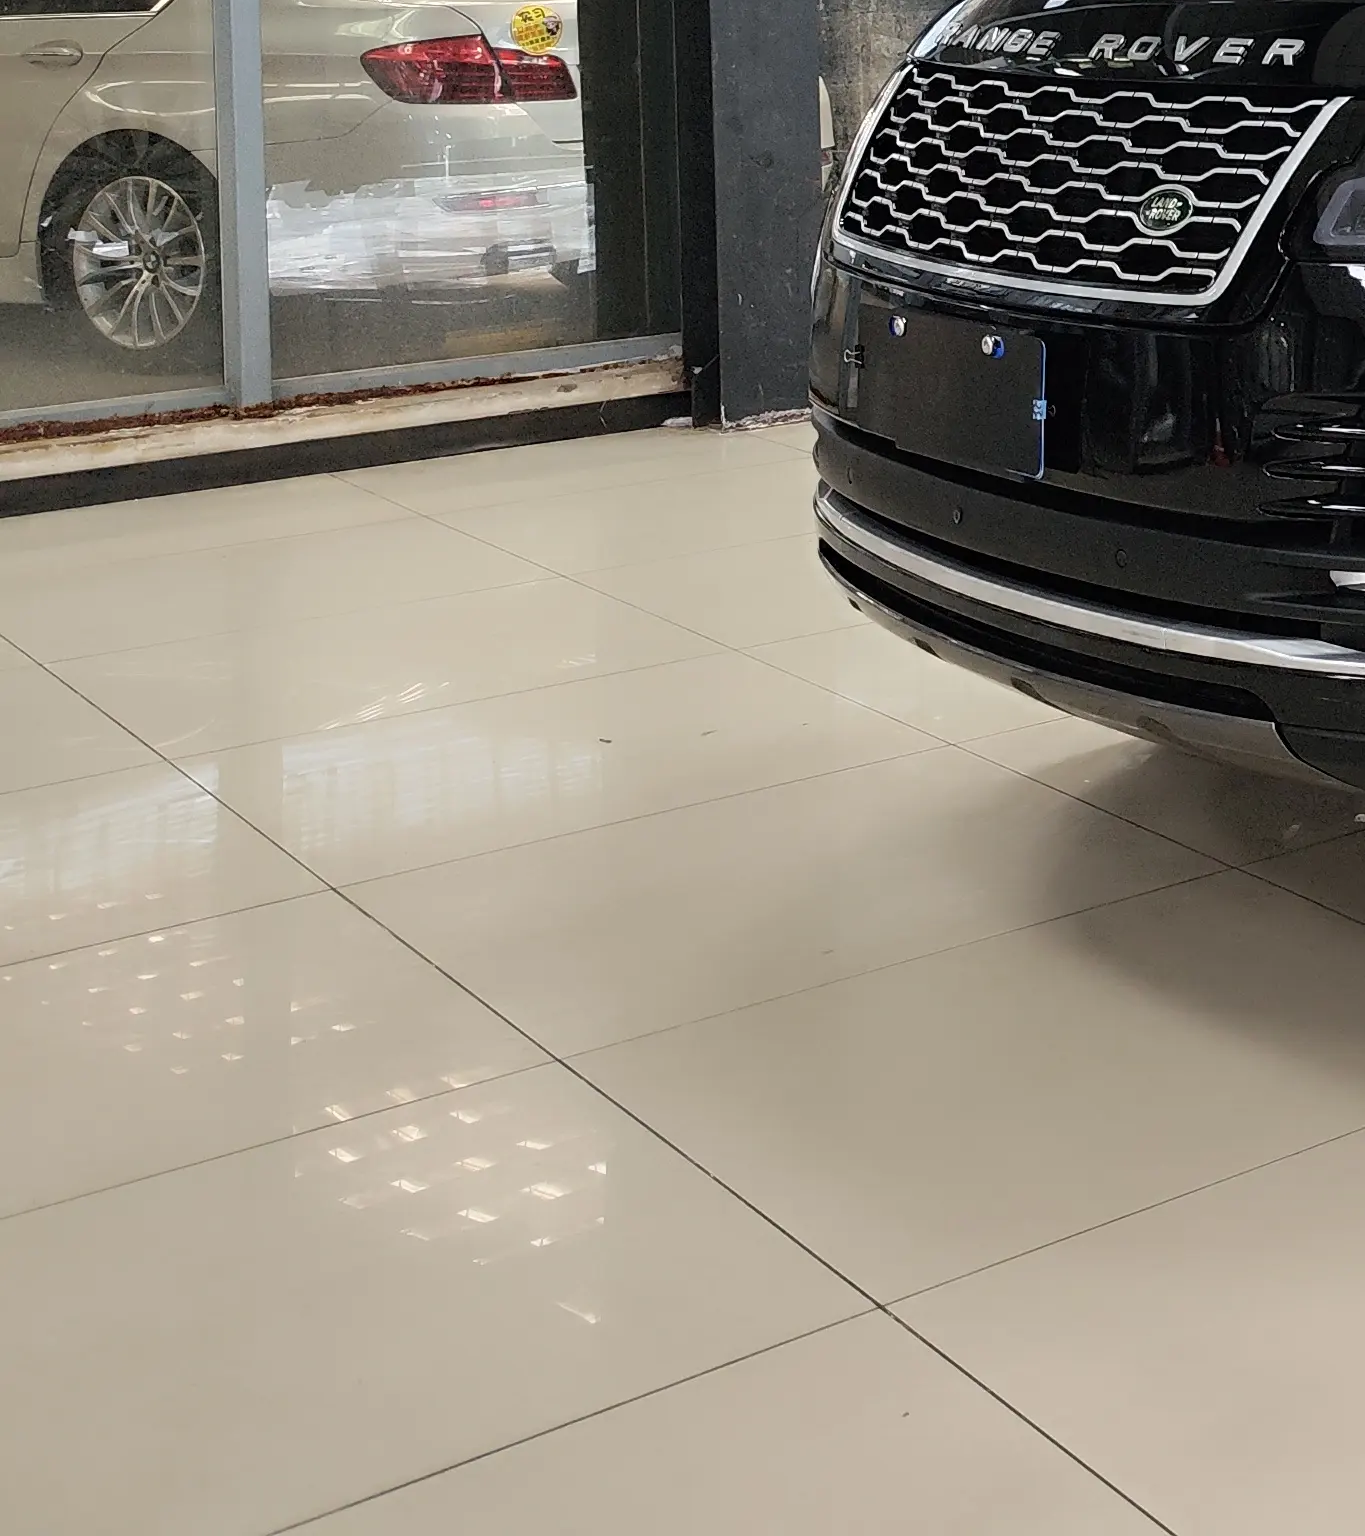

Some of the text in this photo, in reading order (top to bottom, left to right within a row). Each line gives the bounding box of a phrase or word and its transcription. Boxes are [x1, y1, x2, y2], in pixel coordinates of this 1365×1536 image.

[935, 21, 1305, 66] RANGE ROVER
[1151, 197, 1178, 208] LAND
[1149, 208, 1181, 221] ROVER
